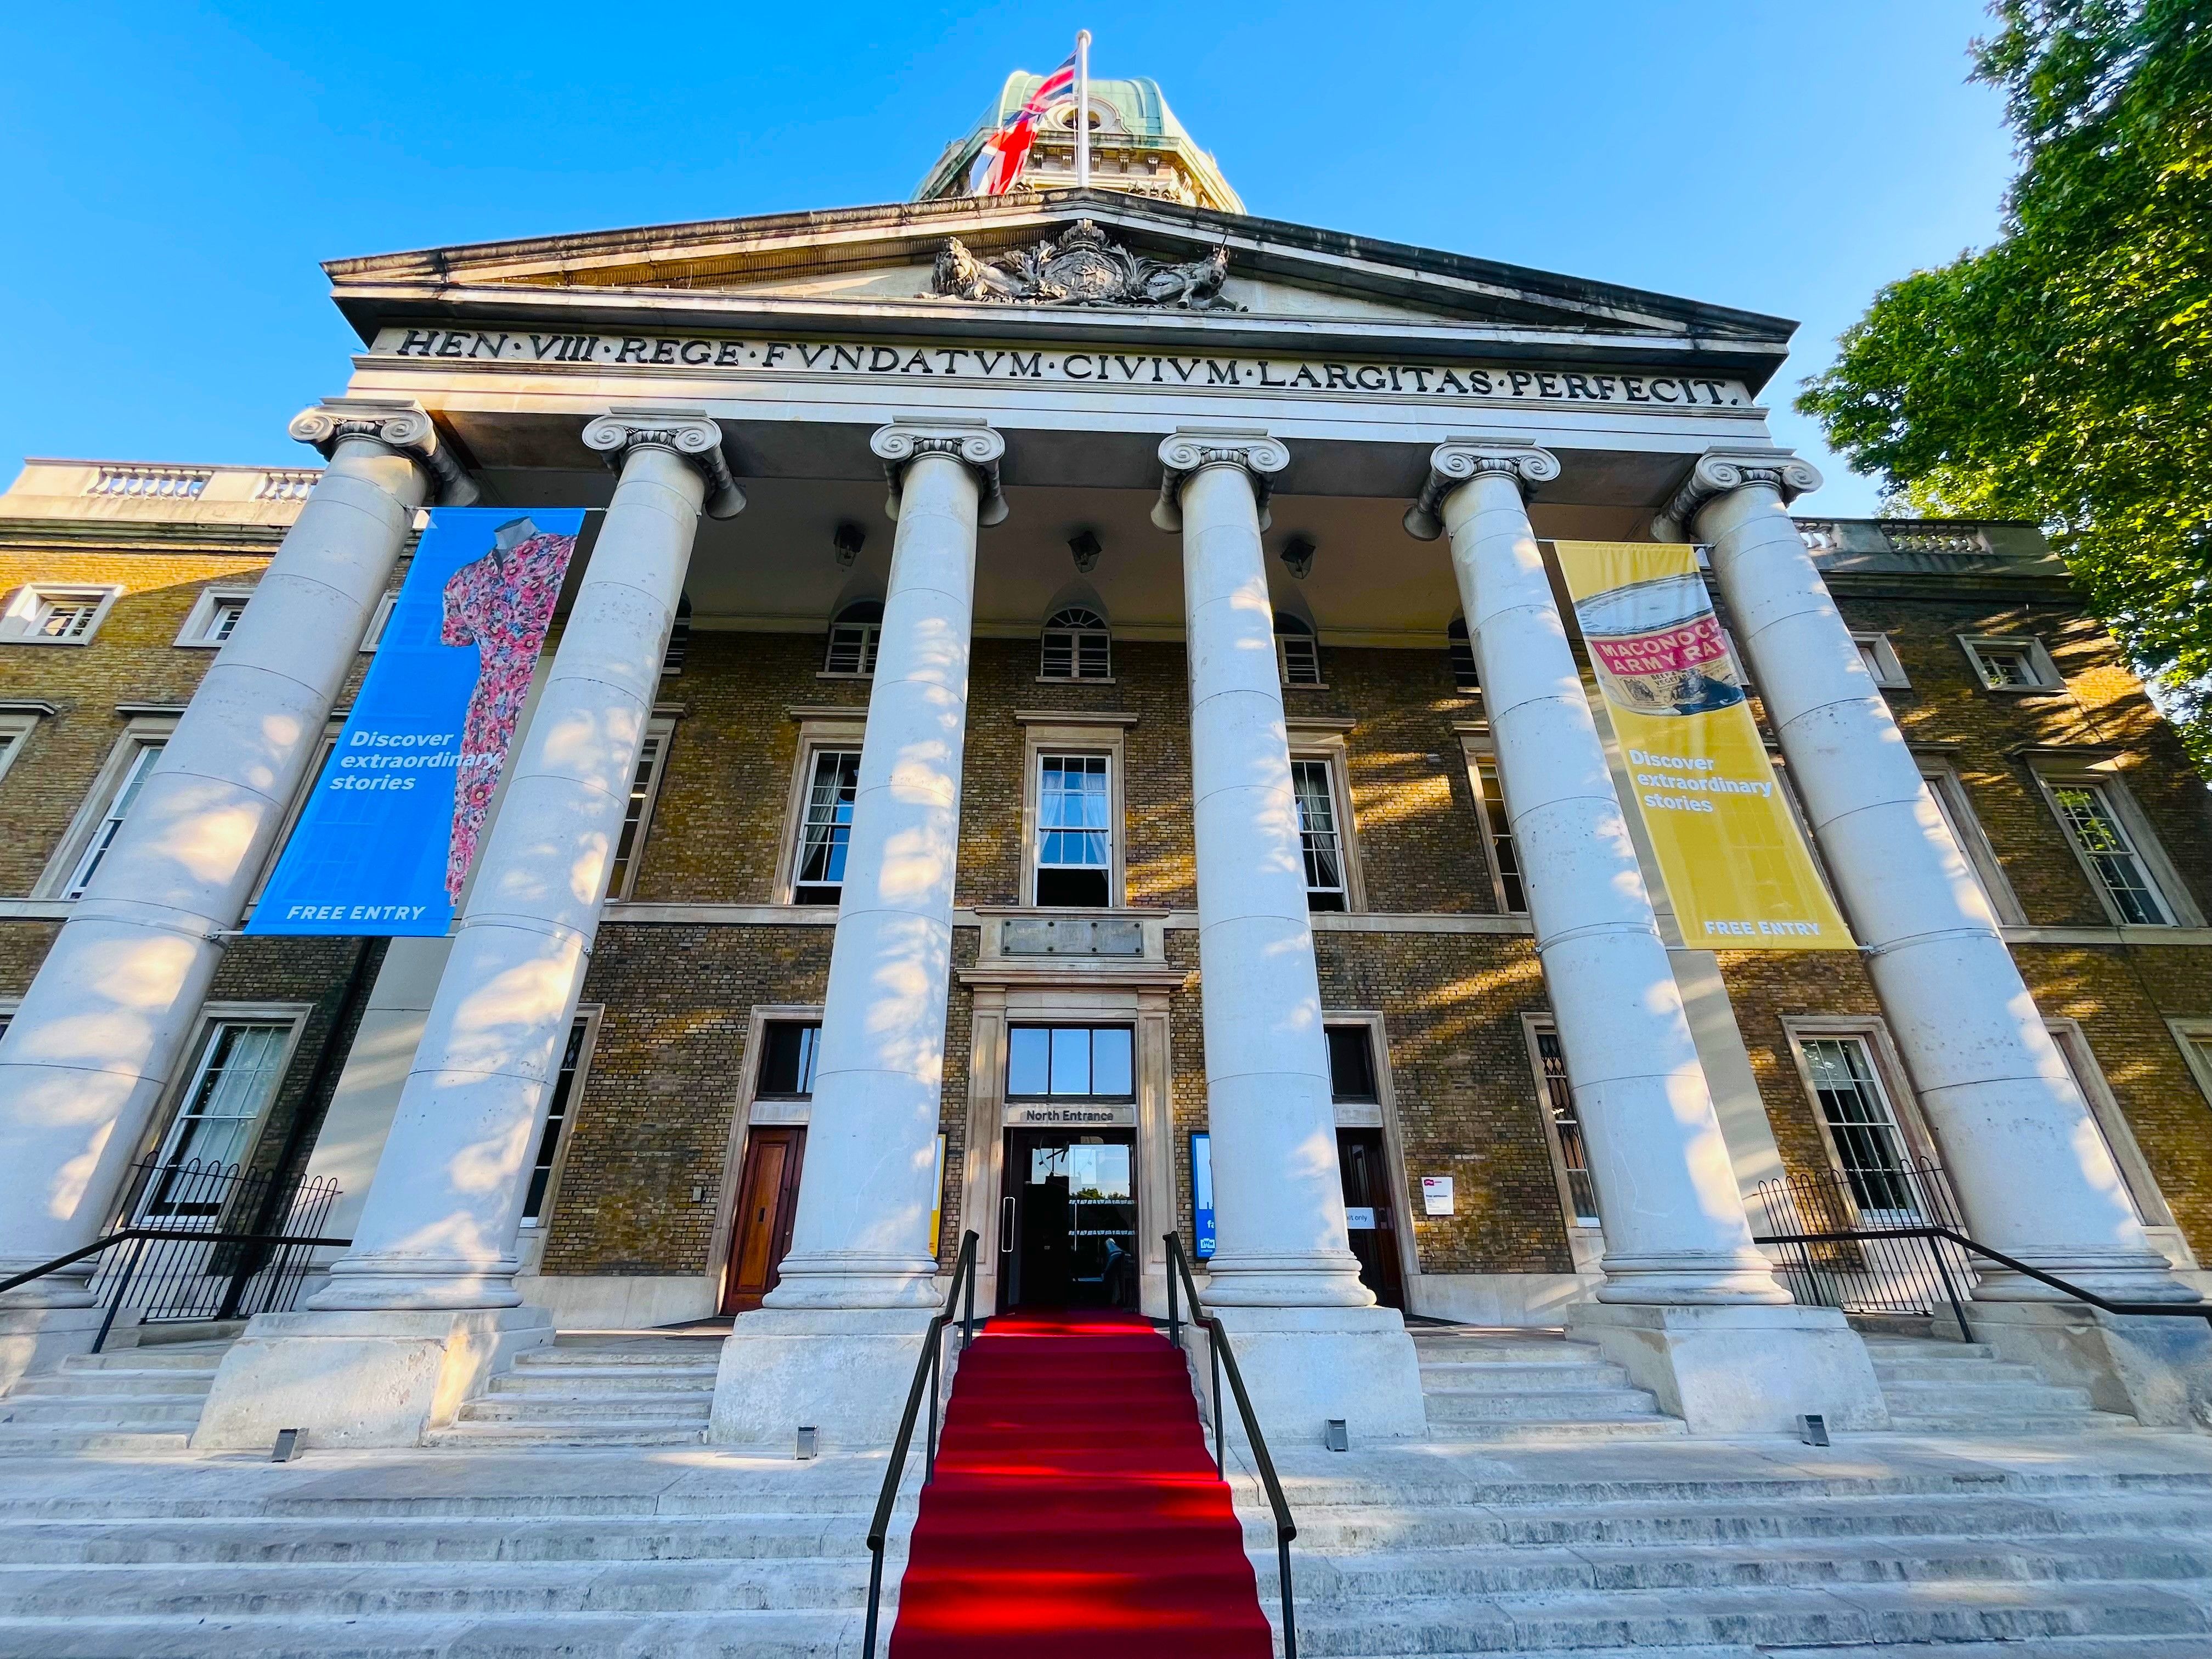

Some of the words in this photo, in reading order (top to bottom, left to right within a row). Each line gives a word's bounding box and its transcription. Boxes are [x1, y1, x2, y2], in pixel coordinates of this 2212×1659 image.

[397, 329, 509, 357] HEN
[528, 334, 600, 362] VIII
[614, 337, 744, 366] REGE
[762, 343, 1042, 377] FVNDATVM
[1063, 354, 1238, 385] CIVIVM
[1257, 360, 1492, 394] LARGITAS
[1613, 652, 1677, 672] ARMY
[1683, 635, 1725, 662] RAT
[350, 731, 454, 747] Discover
[340, 752, 500, 769] extraordinary
[1629, 749, 1714, 771] Discover
[329, 774, 416, 791] stories
[1637, 773, 1772, 798] extraordinary
[1644, 793, 1714, 812] stories
[286, 905, 346, 920] FREE
[349, 905, 426, 921] ENTRY
[1703, 921, 1756, 935] FREE
[1757, 921, 1821, 936] ENTRY
[1026, 1110, 1060, 1121] North
[1063, 1110, 1114, 1121] Entrance
